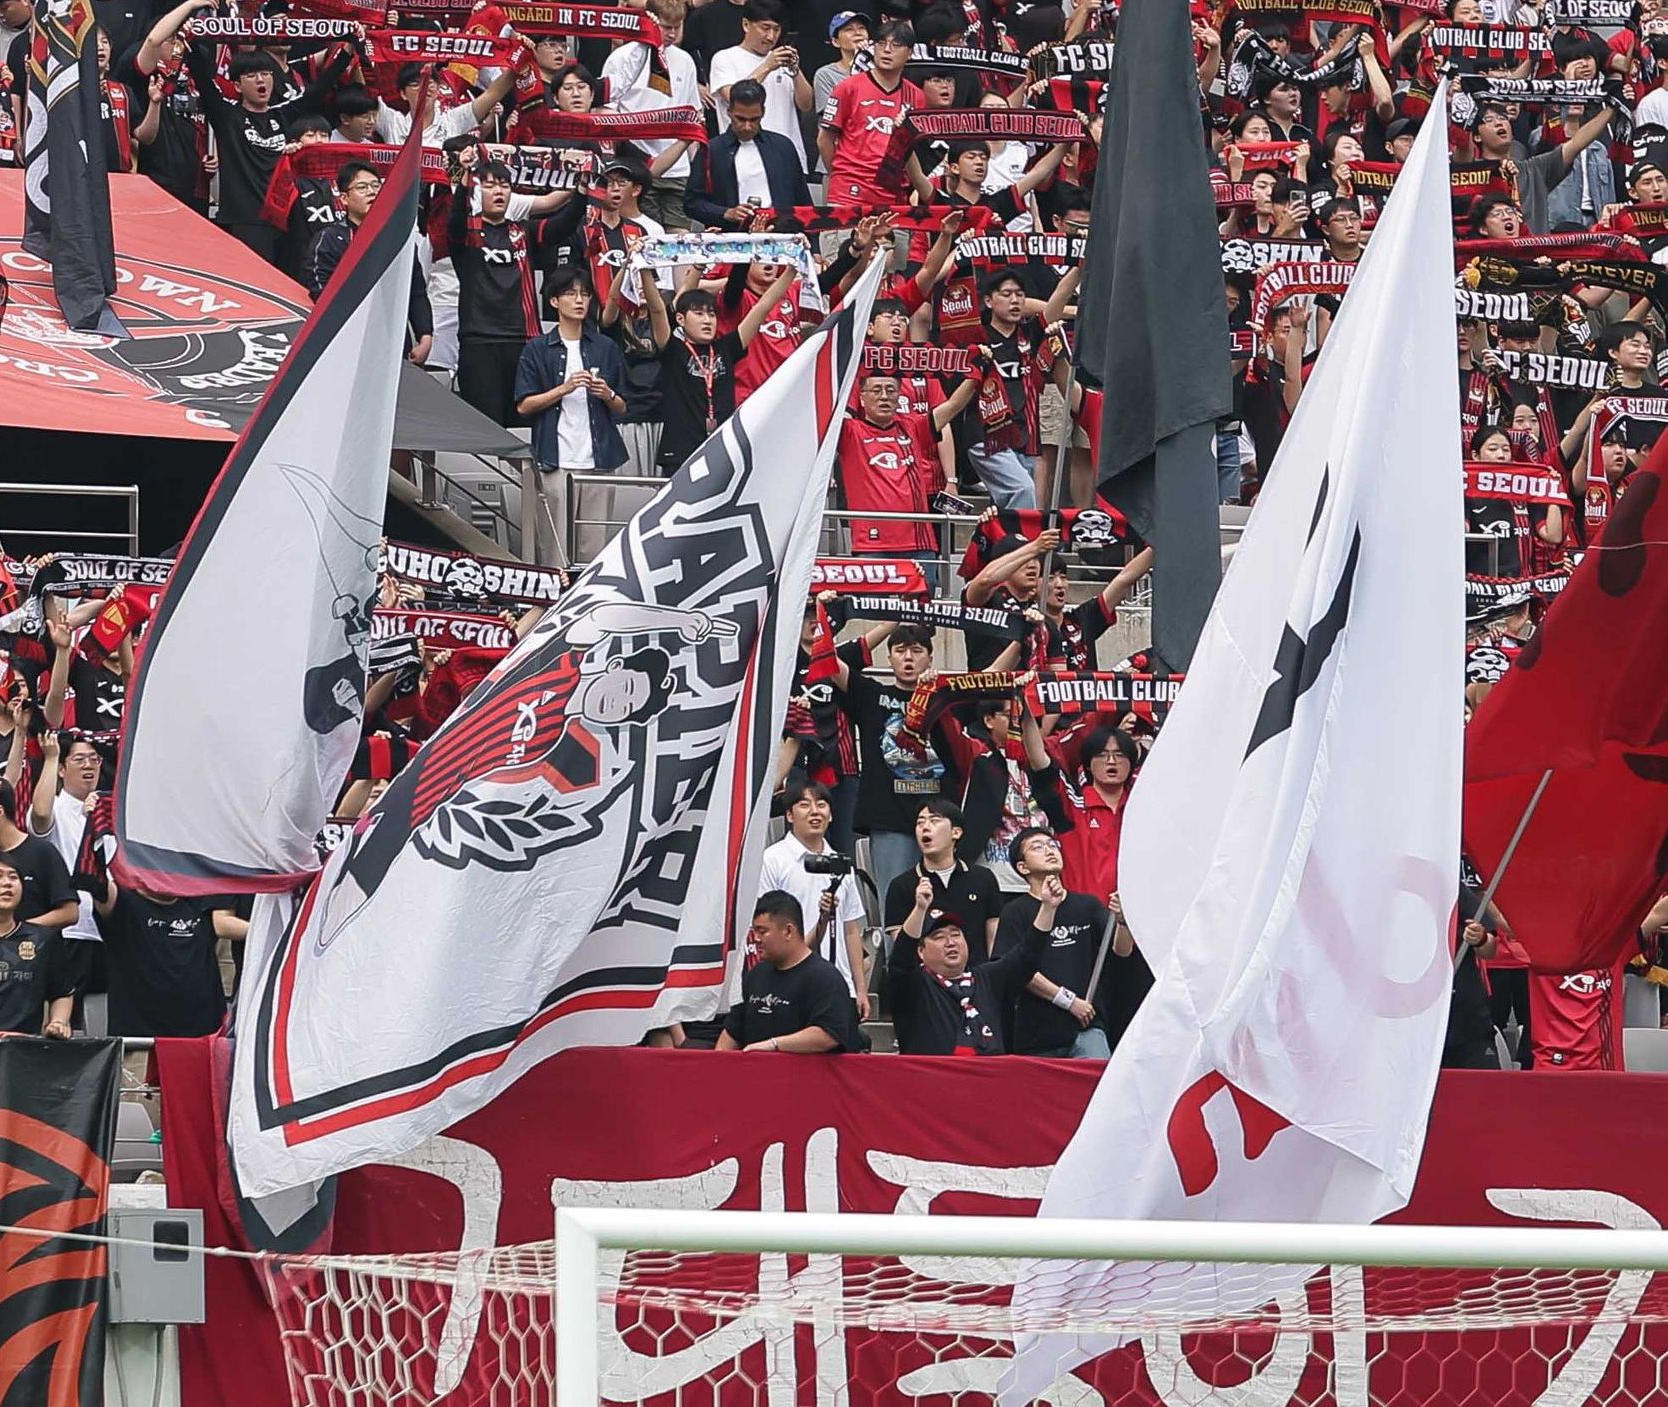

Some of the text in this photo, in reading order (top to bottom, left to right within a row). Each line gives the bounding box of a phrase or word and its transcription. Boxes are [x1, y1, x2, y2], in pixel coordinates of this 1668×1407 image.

[393, 36, 495, 56] FC SEOUL
[866, 345, 971, 374] FC SEOUL
[1529, 356, 1609, 388] SEOUL
[1036, 681, 1179, 703] FOOTBALL CLUB
